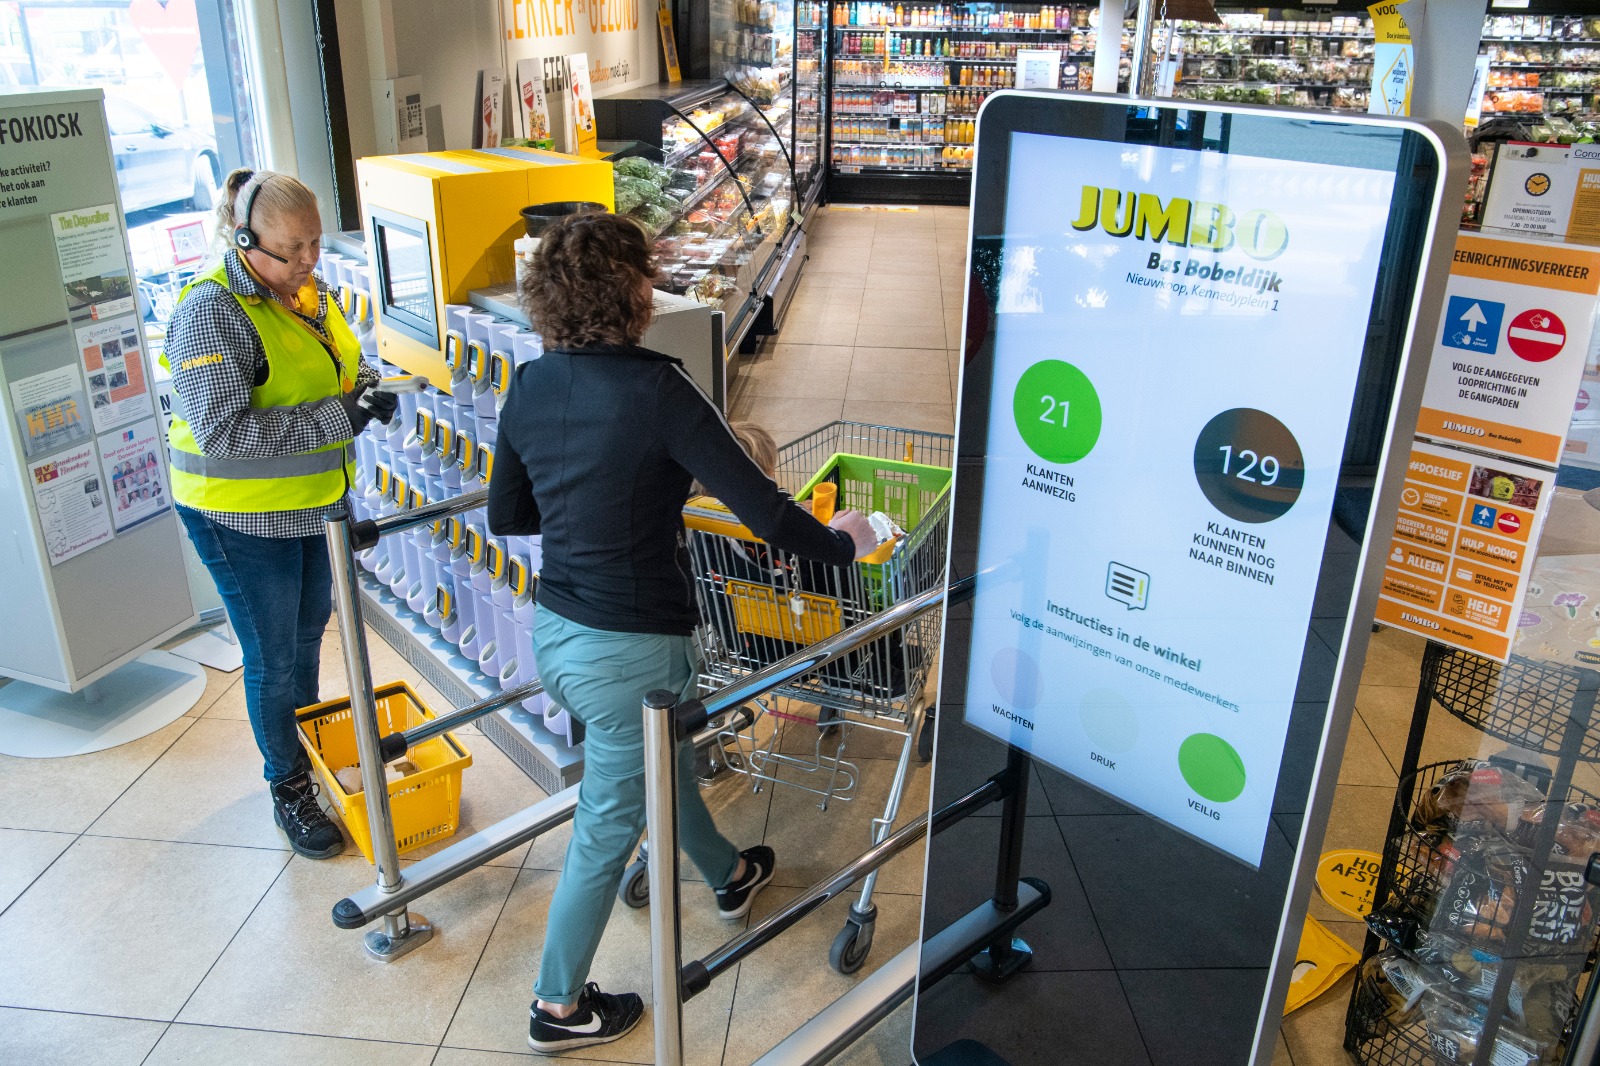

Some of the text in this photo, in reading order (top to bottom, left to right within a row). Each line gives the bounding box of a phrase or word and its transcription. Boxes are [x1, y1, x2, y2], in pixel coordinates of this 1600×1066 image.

[507, 0, 576, 40] EKKER
[1375, 4, 1399, 16] VOO
[11, 161, 51, 176] activiteit?
[16, 179, 30, 191] ook
[32, 180, 45, 189] aan
[7, 195, 38, 207] klanten
[1512, 207, 1551, 216] OPENINGSTIJDEN
[1071, 185, 1289, 261] JUMBO
[1147, 252, 1283, 295] Bas Bobeldijk
[1453, 250, 1589, 280] EENRICHTINGSVERKEER
[1126, 272, 1188, 296] Nieuwkoop,
[1191, 284, 1269, 309] Kennedyplein
[181, 353, 223, 372] JUMBO
[1452, 362, 1540, 387] VOLG DE AANGEGEVEN
[1458, 376, 1527, 398] LOOPRICHTING IN
[1459, 389, 1519, 409] DE GANGPADEN
[1039, 395, 1070, 428] 21
[1442, 421, 1485, 437] JUMBO
[1026, 463, 1074, 487] KLANTEN
[1219, 445, 1280, 486] 129
[1409, 461, 1463, 481] #DOESLIEF
[1022, 477, 1076, 503] AANWEZIG
[1207, 521, 1266, 549] KLANTEN
[1193, 533, 1275, 569] KUNNEN NOG
[1461, 537, 1484, 549] HULP
[1486, 544, 1518, 560] NODIG
[1189, 548, 1274, 586] NAAR BINNEN
[1407, 555, 1444, 575] ALLEEN
[1467, 598, 1502, 619] HELP!
[1400, 612, 1440, 630] JUMBO
[1046, 599, 1201, 672] Instructies in de winkel
[1010, 608, 1239, 713] Volg de aanwijzingen van onze medewerkers
[992, 704, 1034, 731] WACHTEN
[1090, 751, 1116, 771] DRUK
[1187, 798, 1221, 821] VEILIG
[1331, 863, 1379, 886] AFST
